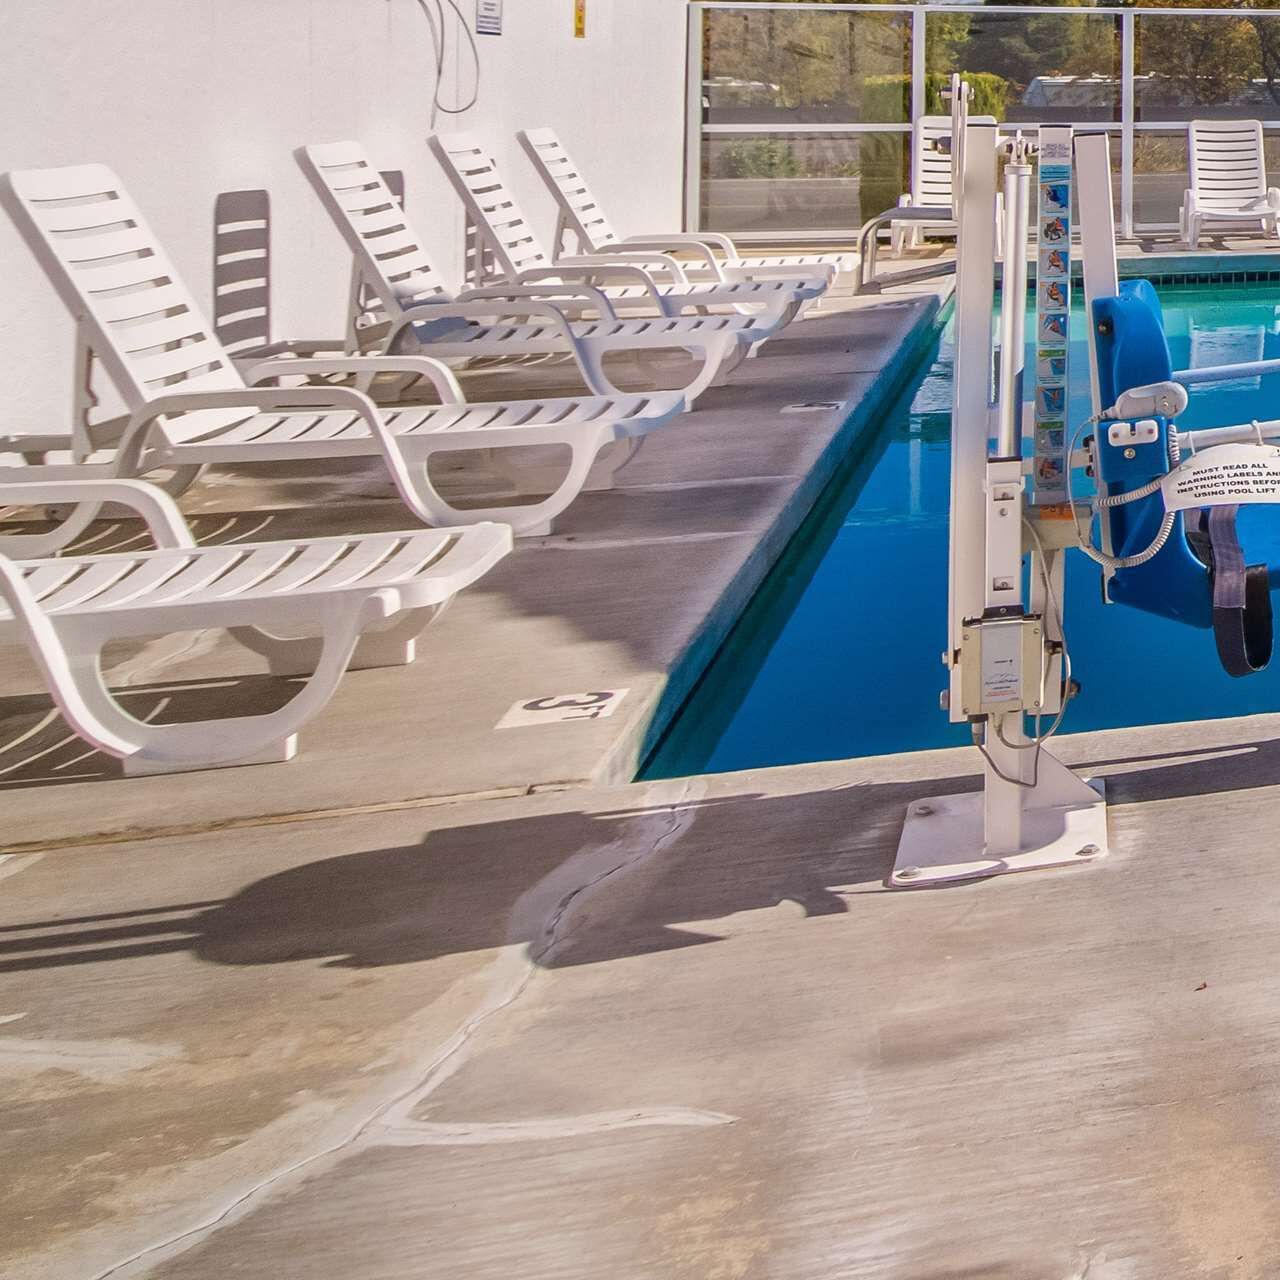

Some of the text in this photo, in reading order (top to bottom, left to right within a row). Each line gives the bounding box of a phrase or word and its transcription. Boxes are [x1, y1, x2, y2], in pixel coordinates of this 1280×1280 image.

[1193, 466, 1220, 476] MUST
[1177, 473, 1224, 487] WARNING
[1177, 480, 1250, 494] INSTRUCTIONS
[1194, 489, 1225, 498] USING
[522, 691, 615, 711] 3
